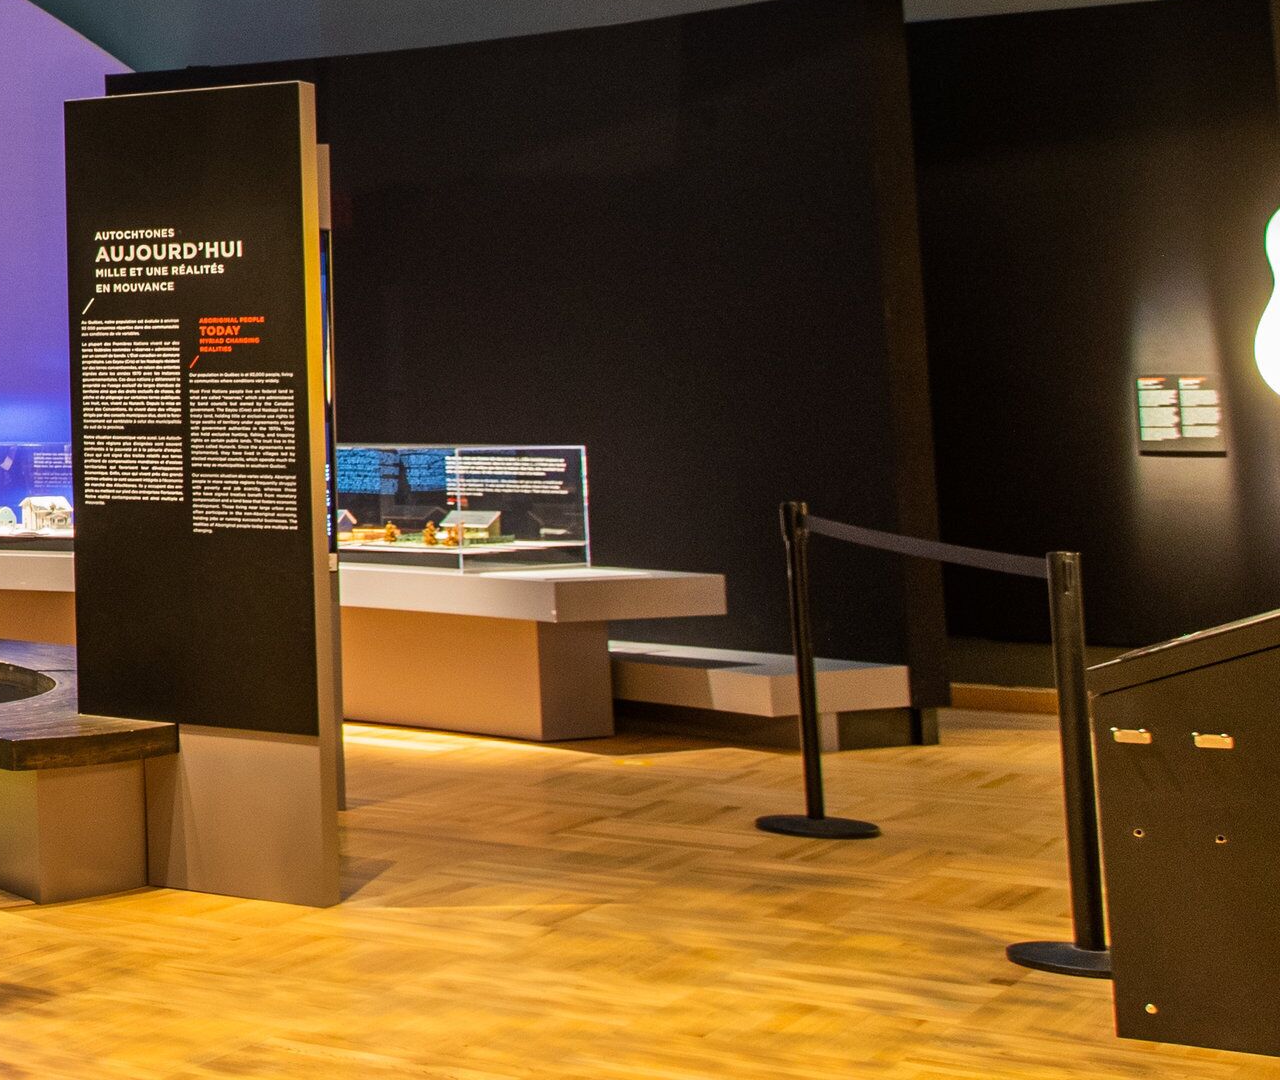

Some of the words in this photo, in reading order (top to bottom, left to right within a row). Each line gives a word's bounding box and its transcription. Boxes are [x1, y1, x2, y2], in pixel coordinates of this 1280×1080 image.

[95, 228, 174, 240] AUTOCHTONES
[95, 241, 243, 262] AUJOURD'HUI
[96, 268, 126, 277] MILLE
[130, 267, 143, 276] ET
[146, 266, 168, 276] UNE
[172, 263, 224, 275] RÉALITÉS
[96, 284, 110, 293] EN
[114, 282, 174, 292] MOUVANCE
[200, 326, 240, 336] TODAY
